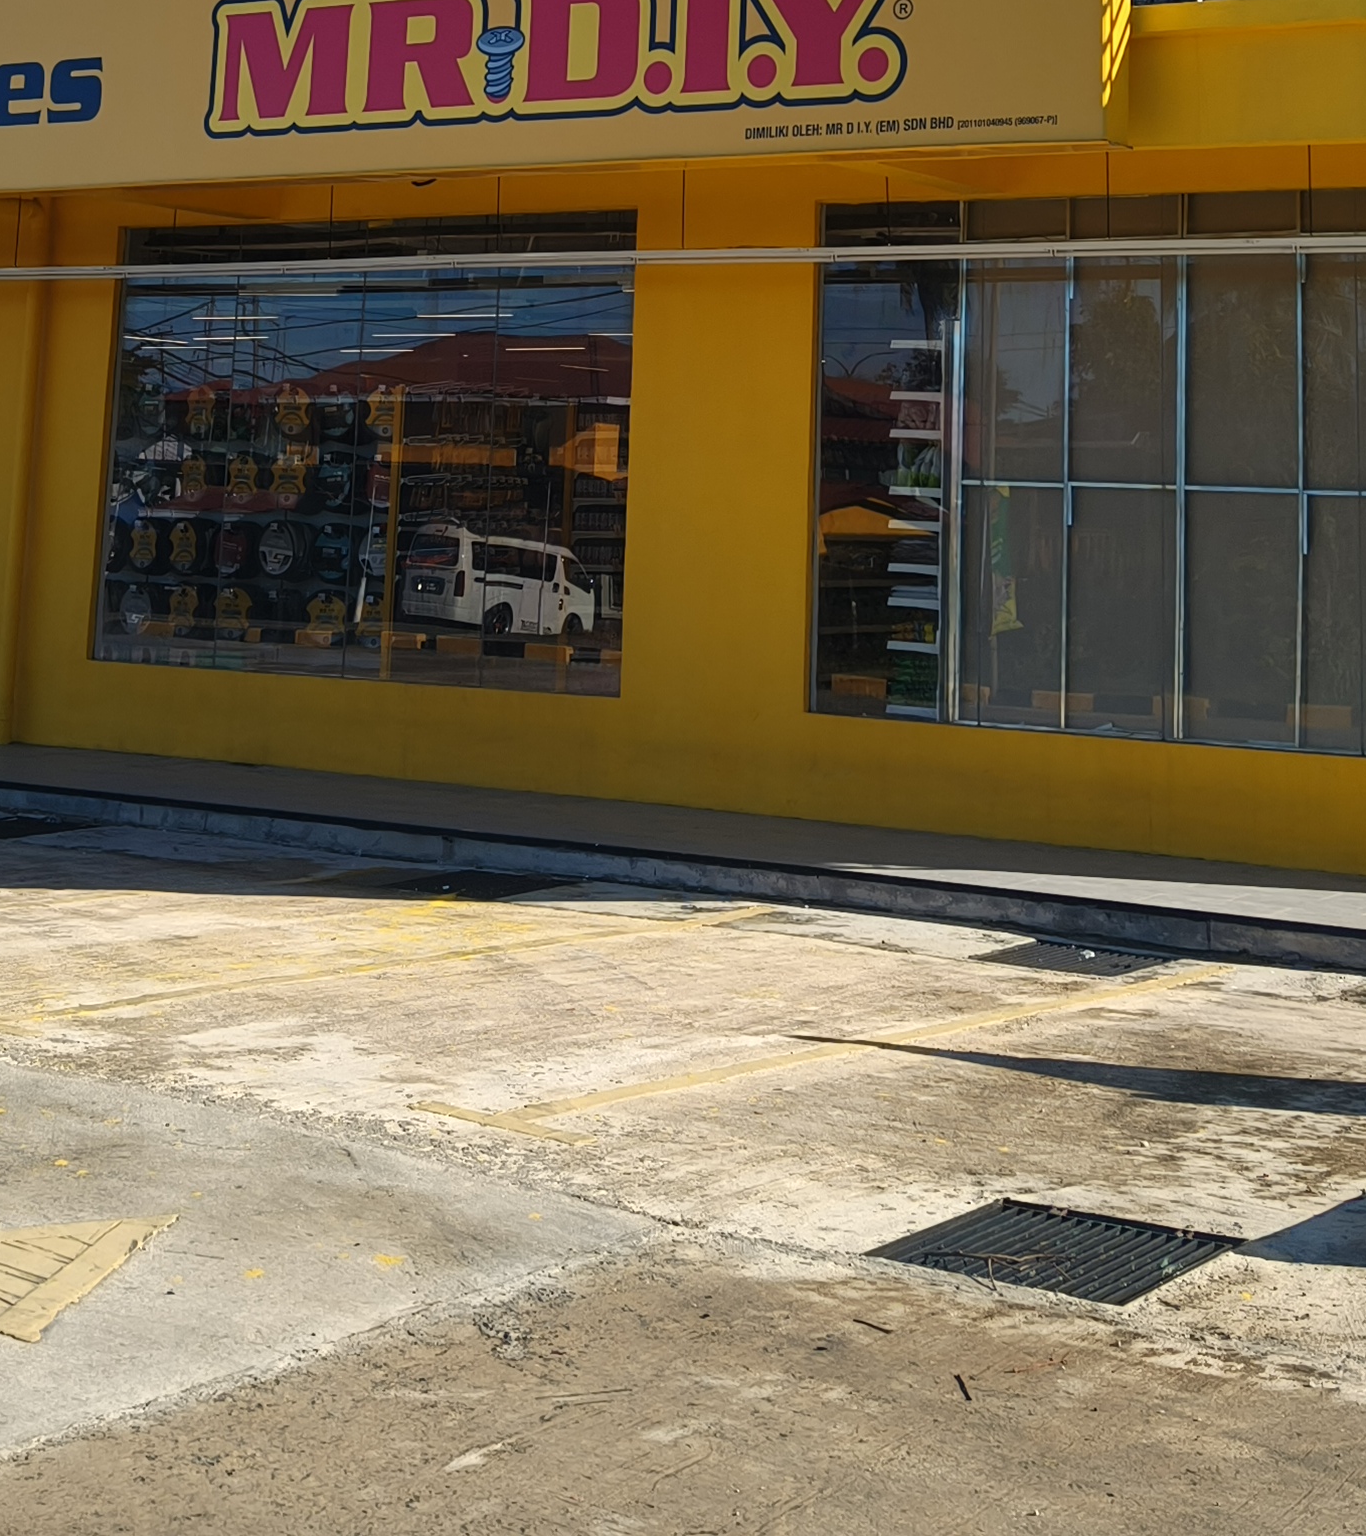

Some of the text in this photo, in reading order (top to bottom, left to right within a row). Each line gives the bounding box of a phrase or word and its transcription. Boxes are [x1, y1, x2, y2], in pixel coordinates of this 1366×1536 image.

[745, 125, 789, 140] DIMILIKI
[792, 124, 823, 137] OLEH:
[825, 123, 843, 135] MR
[846, 122, 854, 134] D
[875, 120, 900, 135] (EM)
[903, 119, 927, 131] SDN
[930, 116, 954, 129] BHD
